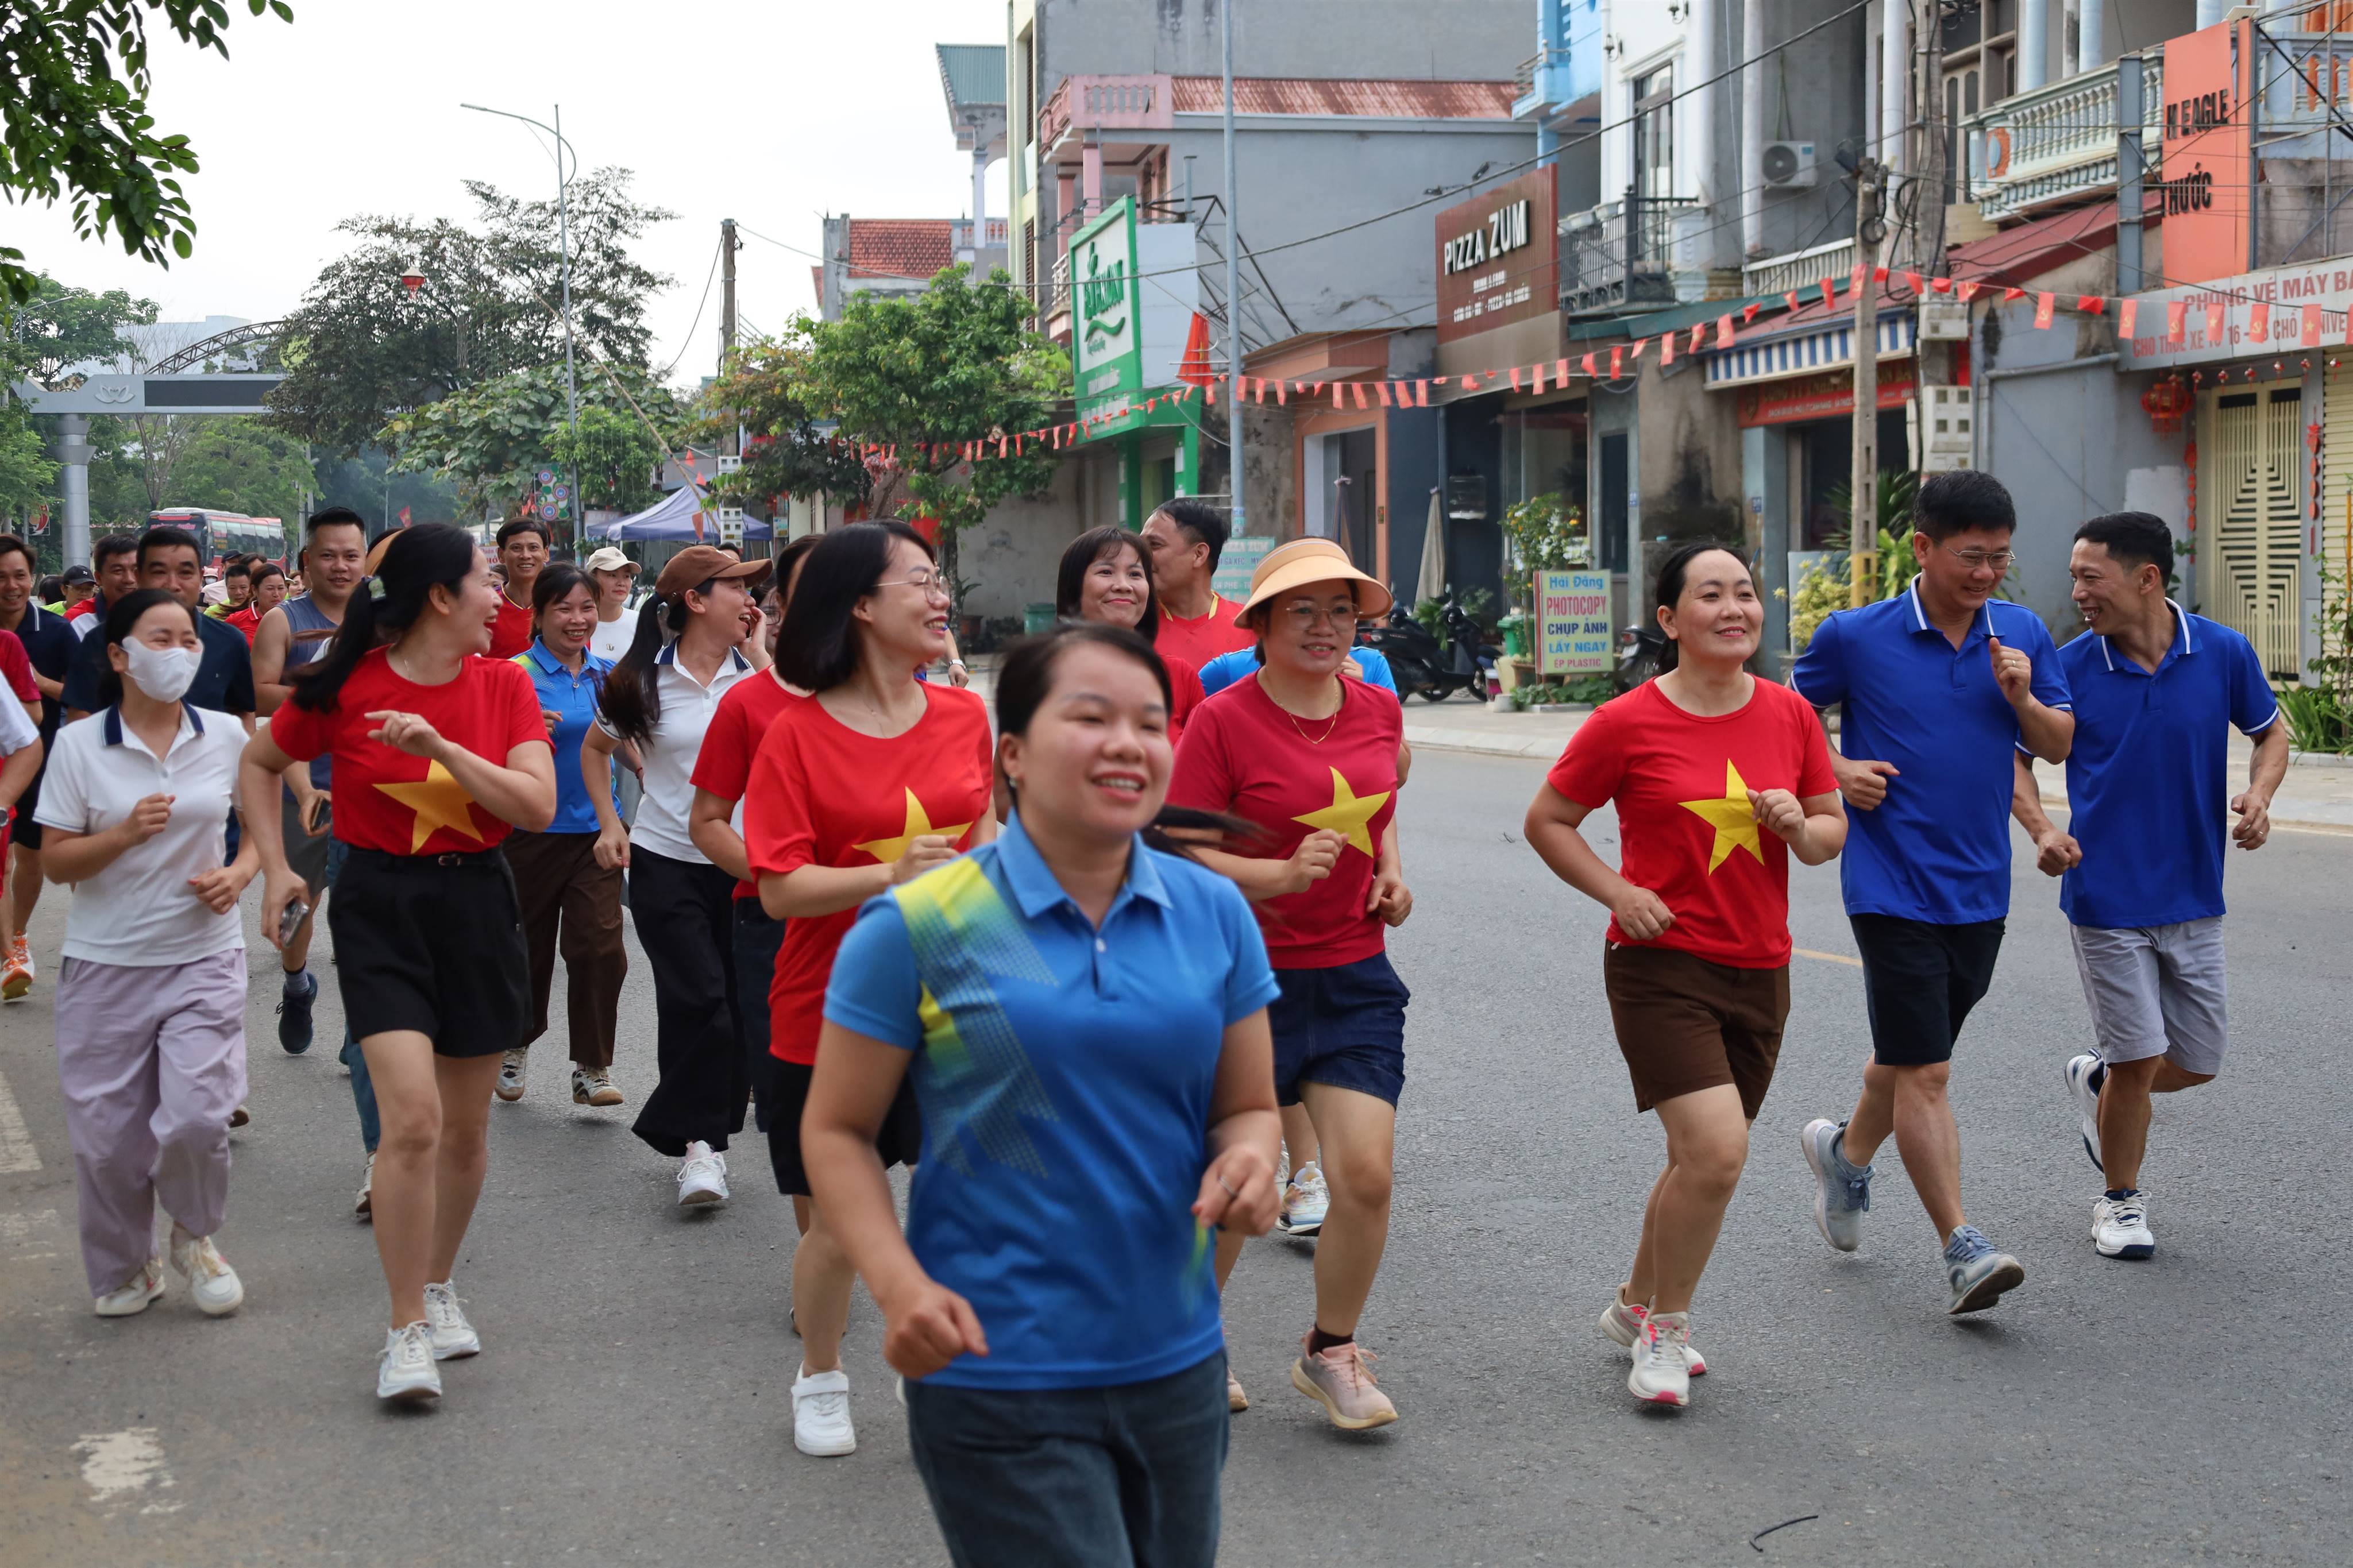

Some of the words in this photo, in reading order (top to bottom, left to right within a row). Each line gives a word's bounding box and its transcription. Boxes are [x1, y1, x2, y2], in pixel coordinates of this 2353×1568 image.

[2181, 89, 2228, 136] EAGLE
[2161, 162, 2212, 218] THƯỚC
[1444, 228, 1486, 276] PIZZA
[1488, 199, 1529, 258] ZUM
[2184, 284, 2247, 314] PHÒNG
[2252, 276, 2277, 302] VÉ
[2282, 271, 2328, 299] MÁY
[2132, 337, 2156, 358] CHO
[2190, 330, 2204, 350] XE
[2227, 325, 2240, 346] 16
[2273, 308, 2297, 340] CHỖ
[1546, 596, 1606, 616] PHOTOCOPY
[1548, 623, 1579, 637] CHỤP
[1583, 617, 1607, 634] ẢNH
[1549, 638, 1571, 654] LẤY
[1575, 641, 1607, 652] NGAY
[1567, 658, 1601, 668] PLASTIC
